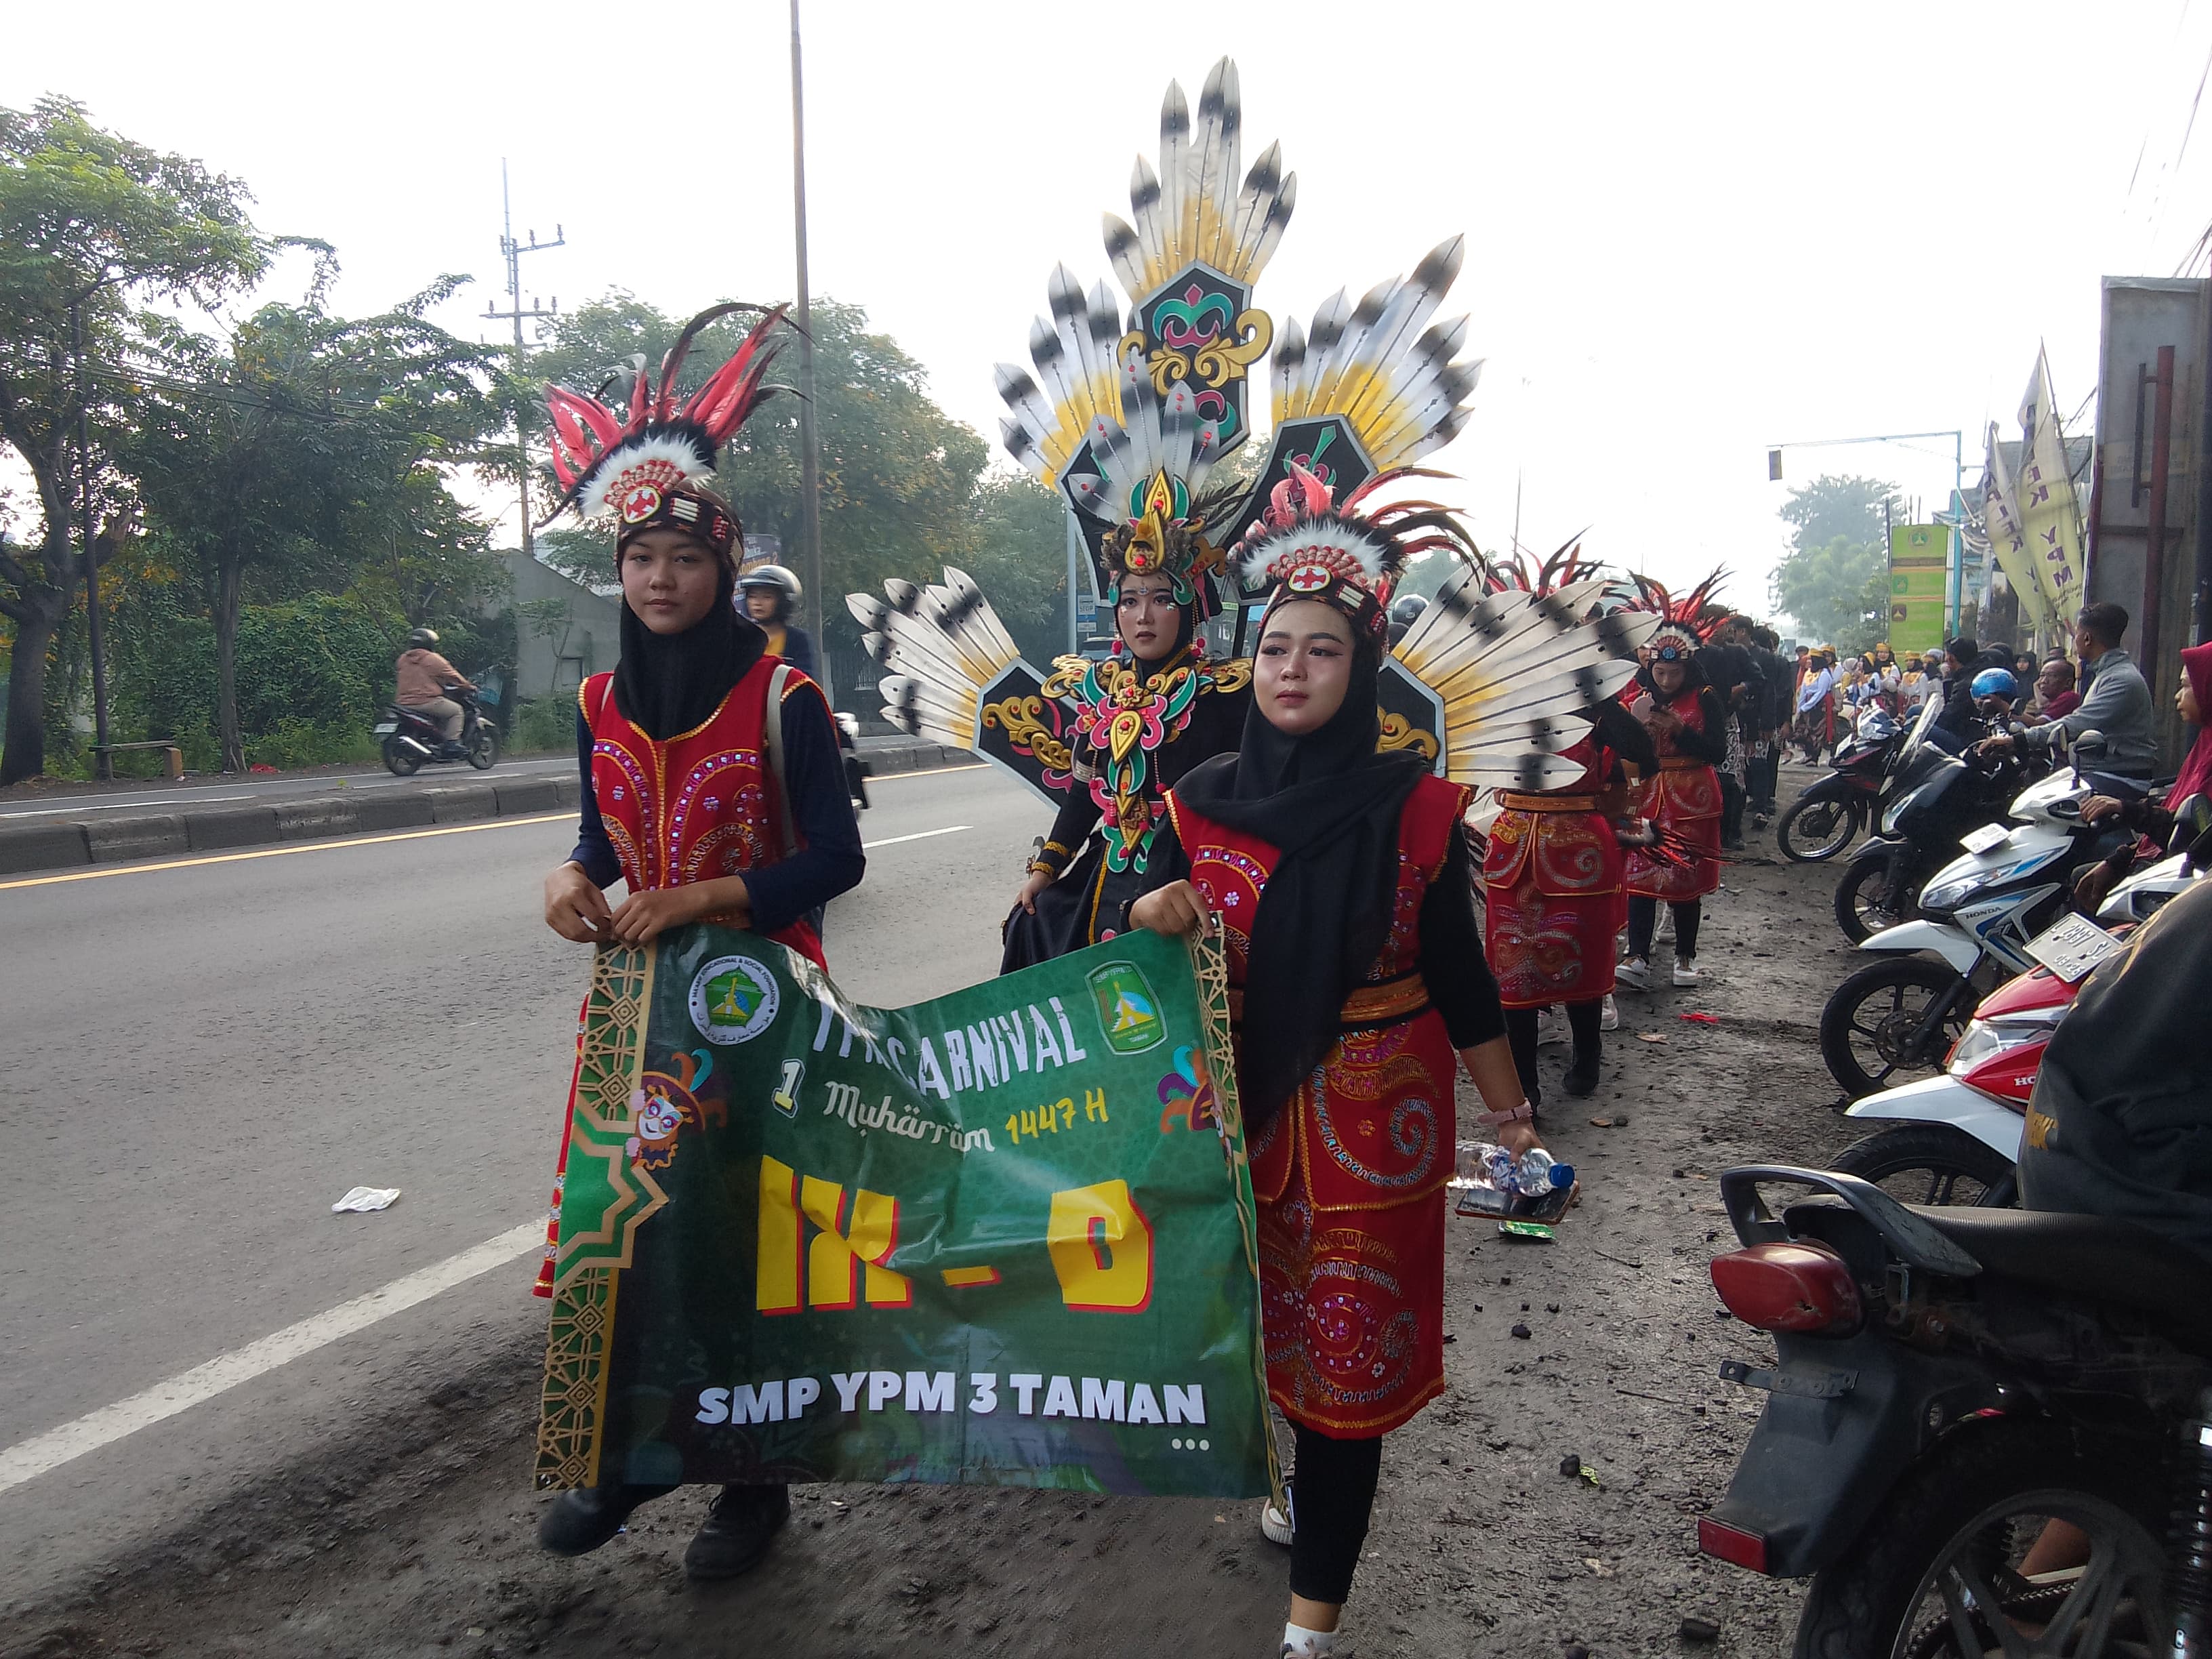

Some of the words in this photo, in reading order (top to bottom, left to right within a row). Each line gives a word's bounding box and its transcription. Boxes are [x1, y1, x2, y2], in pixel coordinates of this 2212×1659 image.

[1965, 906, 2003, 919] HONDA
[887, 996, 1086, 1100] CARNIVAL
[773, 1060, 802, 1113] 1
[1005, 1097, 1076, 1145] 1447
[1085, 1086, 1110, 1123] H
[695, 1376, 821, 1424] SMP
[830, 1371, 956, 1412] YPM
[968, 1372, 998, 1414] 3
[1009, 1373, 1206, 1424] TAMAN
